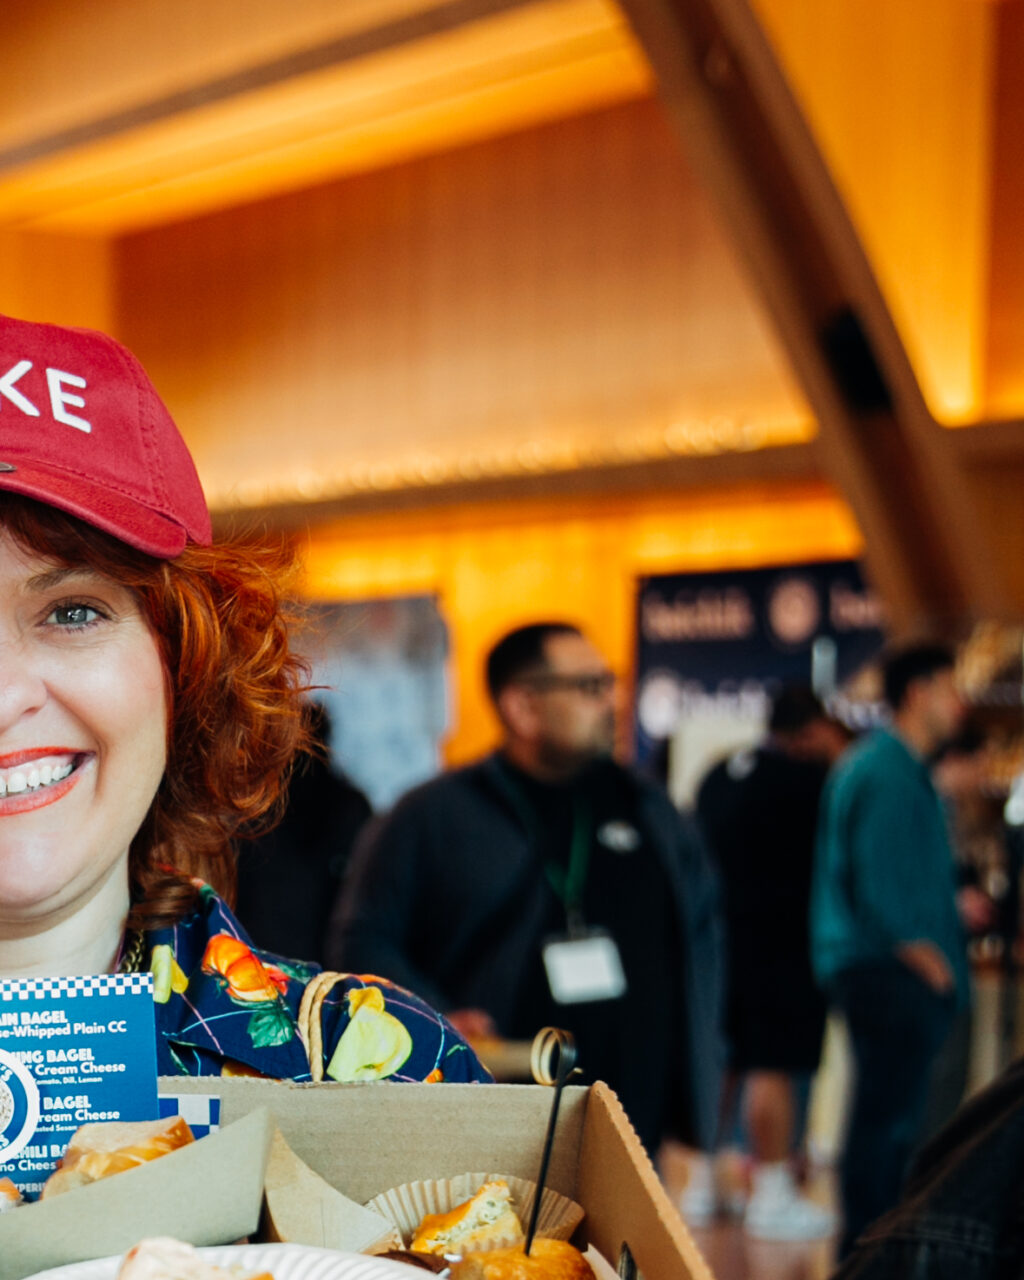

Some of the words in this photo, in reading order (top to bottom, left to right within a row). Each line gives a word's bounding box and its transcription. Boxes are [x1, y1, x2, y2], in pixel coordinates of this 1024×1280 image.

[21, 1010, 68, 1025] BAGEL
[73, 1022, 105, 1035] Plain
[108, 1021, 127, 1033] CC
[46, 1048, 95, 1064] BAGEL
[34, 1063, 78, 1077] Cream
[80, 1061, 126, 1074] Cheese
[43, 1095, 92, 1110] BAGEL
[37, 1112, 72, 1122] ream
[74, 1109, 120, 1121] Cheese
[18, 1160, 57, 1172] Chees
